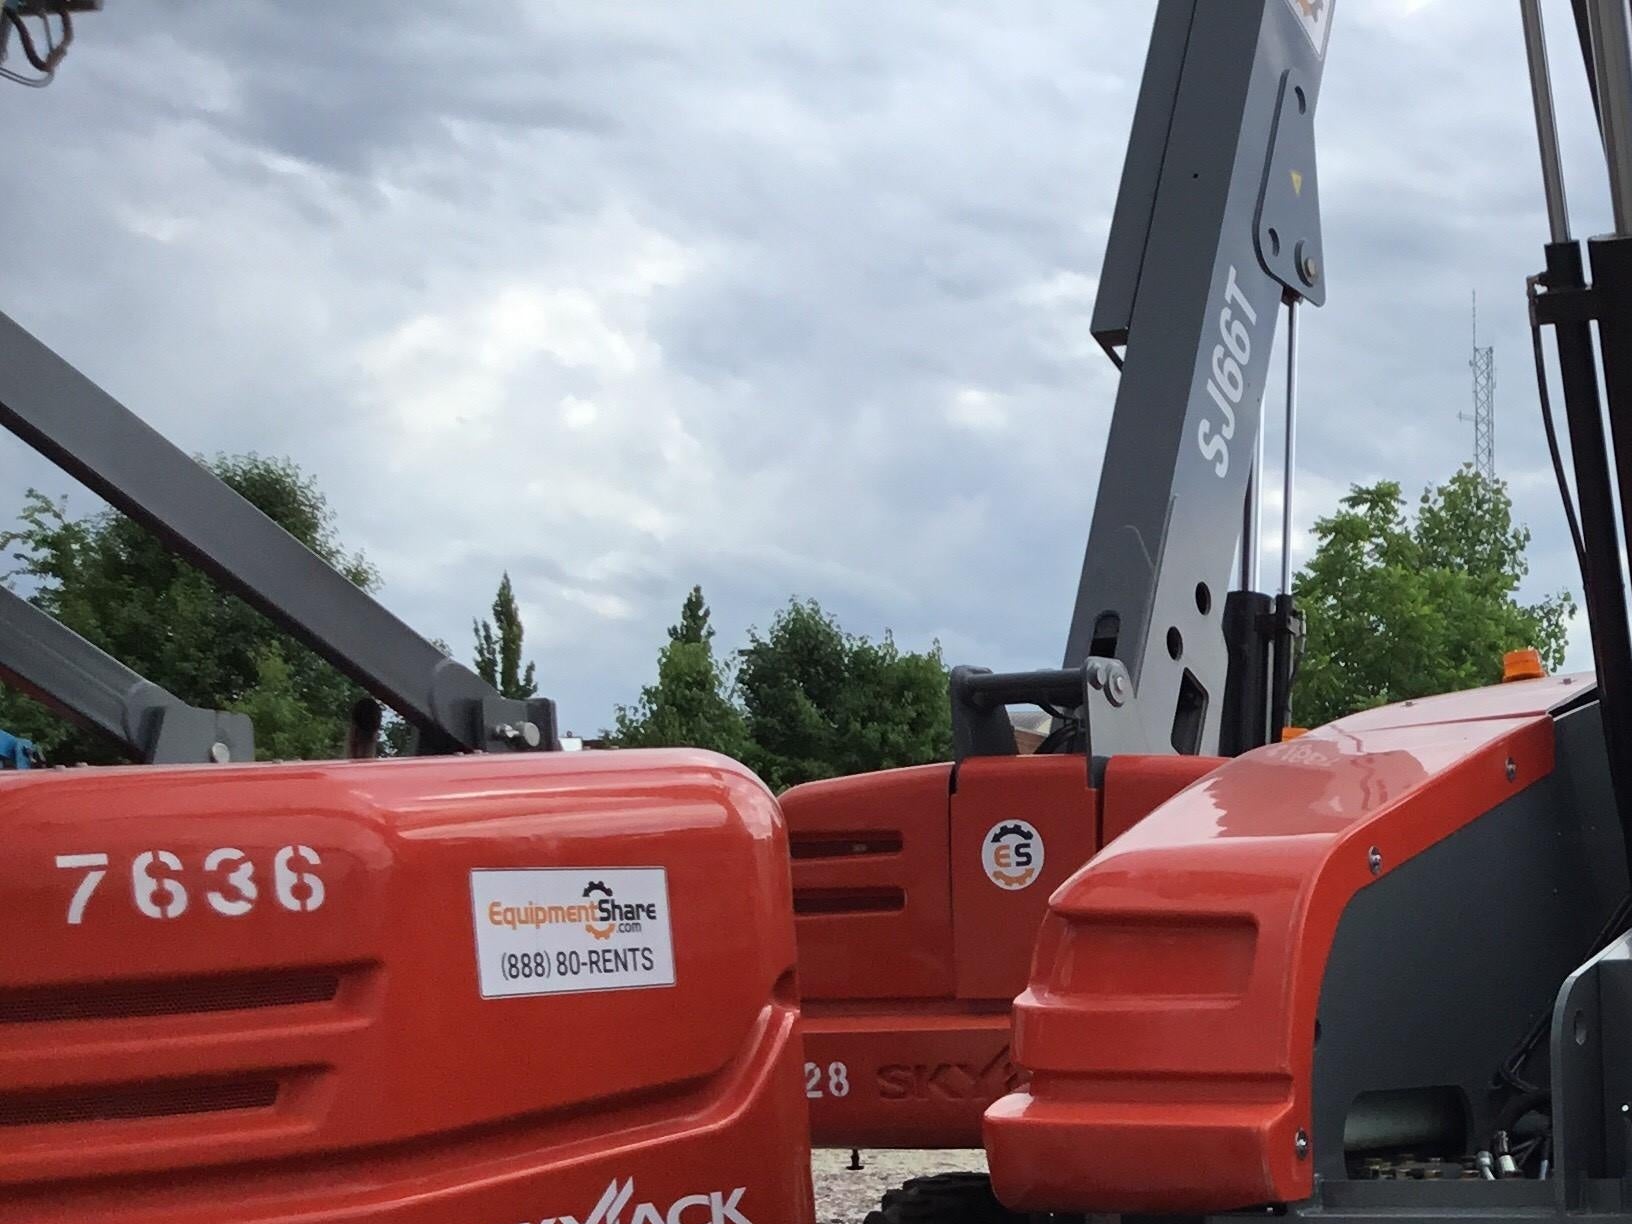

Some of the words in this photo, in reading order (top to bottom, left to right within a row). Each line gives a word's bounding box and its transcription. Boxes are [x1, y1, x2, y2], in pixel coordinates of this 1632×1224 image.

[1198, 264, 1257, 478] SJ66T
[994, 843, 1032, 868] ES
[55, 844, 326, 924] 7636
[489, 899, 657, 930] EquipmentShare
[502, 950, 551, 980] (888)
[556, 947, 654, 976] 80-RENTS
[876, 1045, 1033, 1101] SKY
